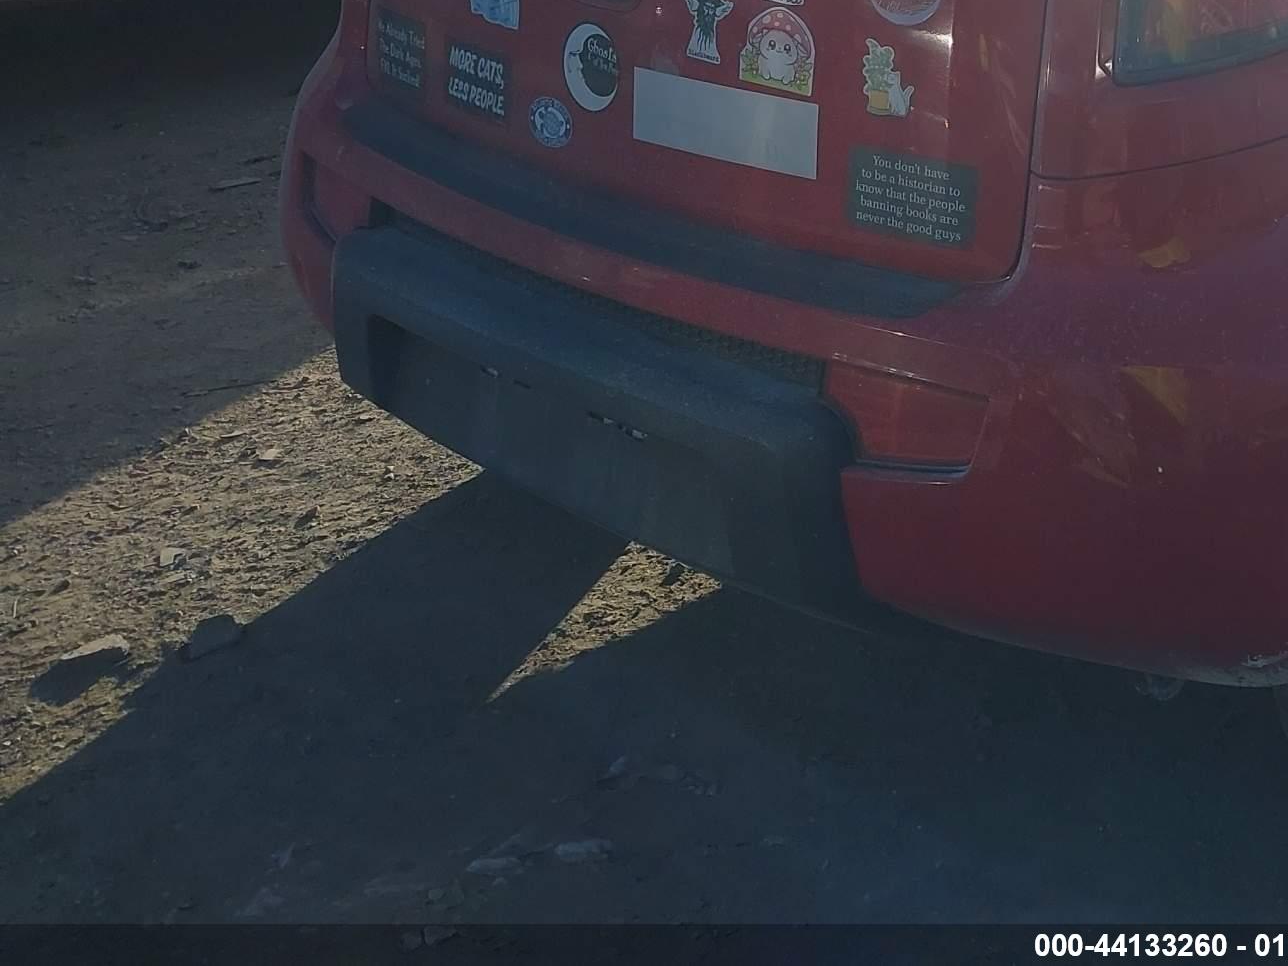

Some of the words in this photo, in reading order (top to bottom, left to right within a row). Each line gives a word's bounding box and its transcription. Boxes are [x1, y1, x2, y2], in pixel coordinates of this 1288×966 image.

[449, 45, 478, 75] MORE
[477, 57, 504, 90] CATS,
[861, 168, 872, 179] to
[875, 170, 887, 182] be
[889, 175, 895, 184] a
[898, 174, 946, 195] historian
[949, 185, 961, 197] to
[872, 154, 892, 169] You
[894, 159, 921, 175] don't
[924, 165, 950, 181] have
[855, 179, 884, 196] know
[886, 187, 906, 201] that
[909, 193, 926, 206] the
[928, 198, 966, 213] people
[860, 195, 904, 217] banning
[906, 205, 937, 222] books
[939, 215, 959, 226] are
[856, 210, 886, 224] never
[887, 216, 904, 229] the
[906, 223, 932, 236] good
[935, 229, 961, 242] guys
